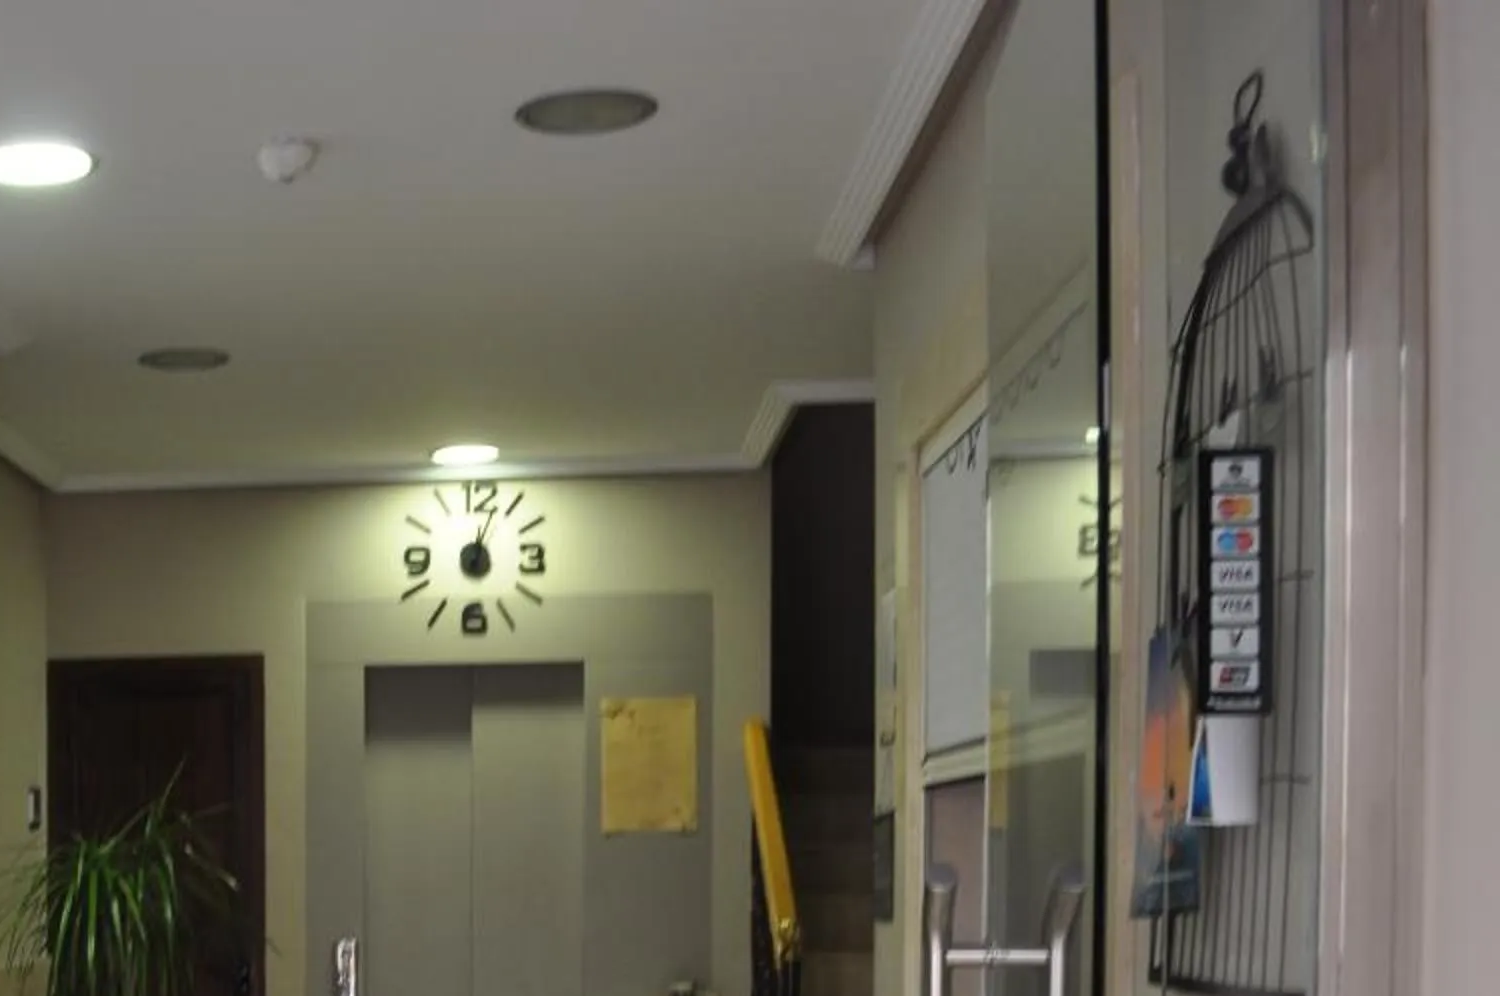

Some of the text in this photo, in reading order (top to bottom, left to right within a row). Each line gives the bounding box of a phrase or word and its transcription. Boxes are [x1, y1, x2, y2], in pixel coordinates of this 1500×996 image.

[462, 479, 499, 513] 12
[404, 546, 431, 576] 9
[518, 543, 546, 574] 3
[1219, 567, 1254, 583] VISA
[460, 602, 488, 635] 6
[1218, 598, 1254, 614] VISA
